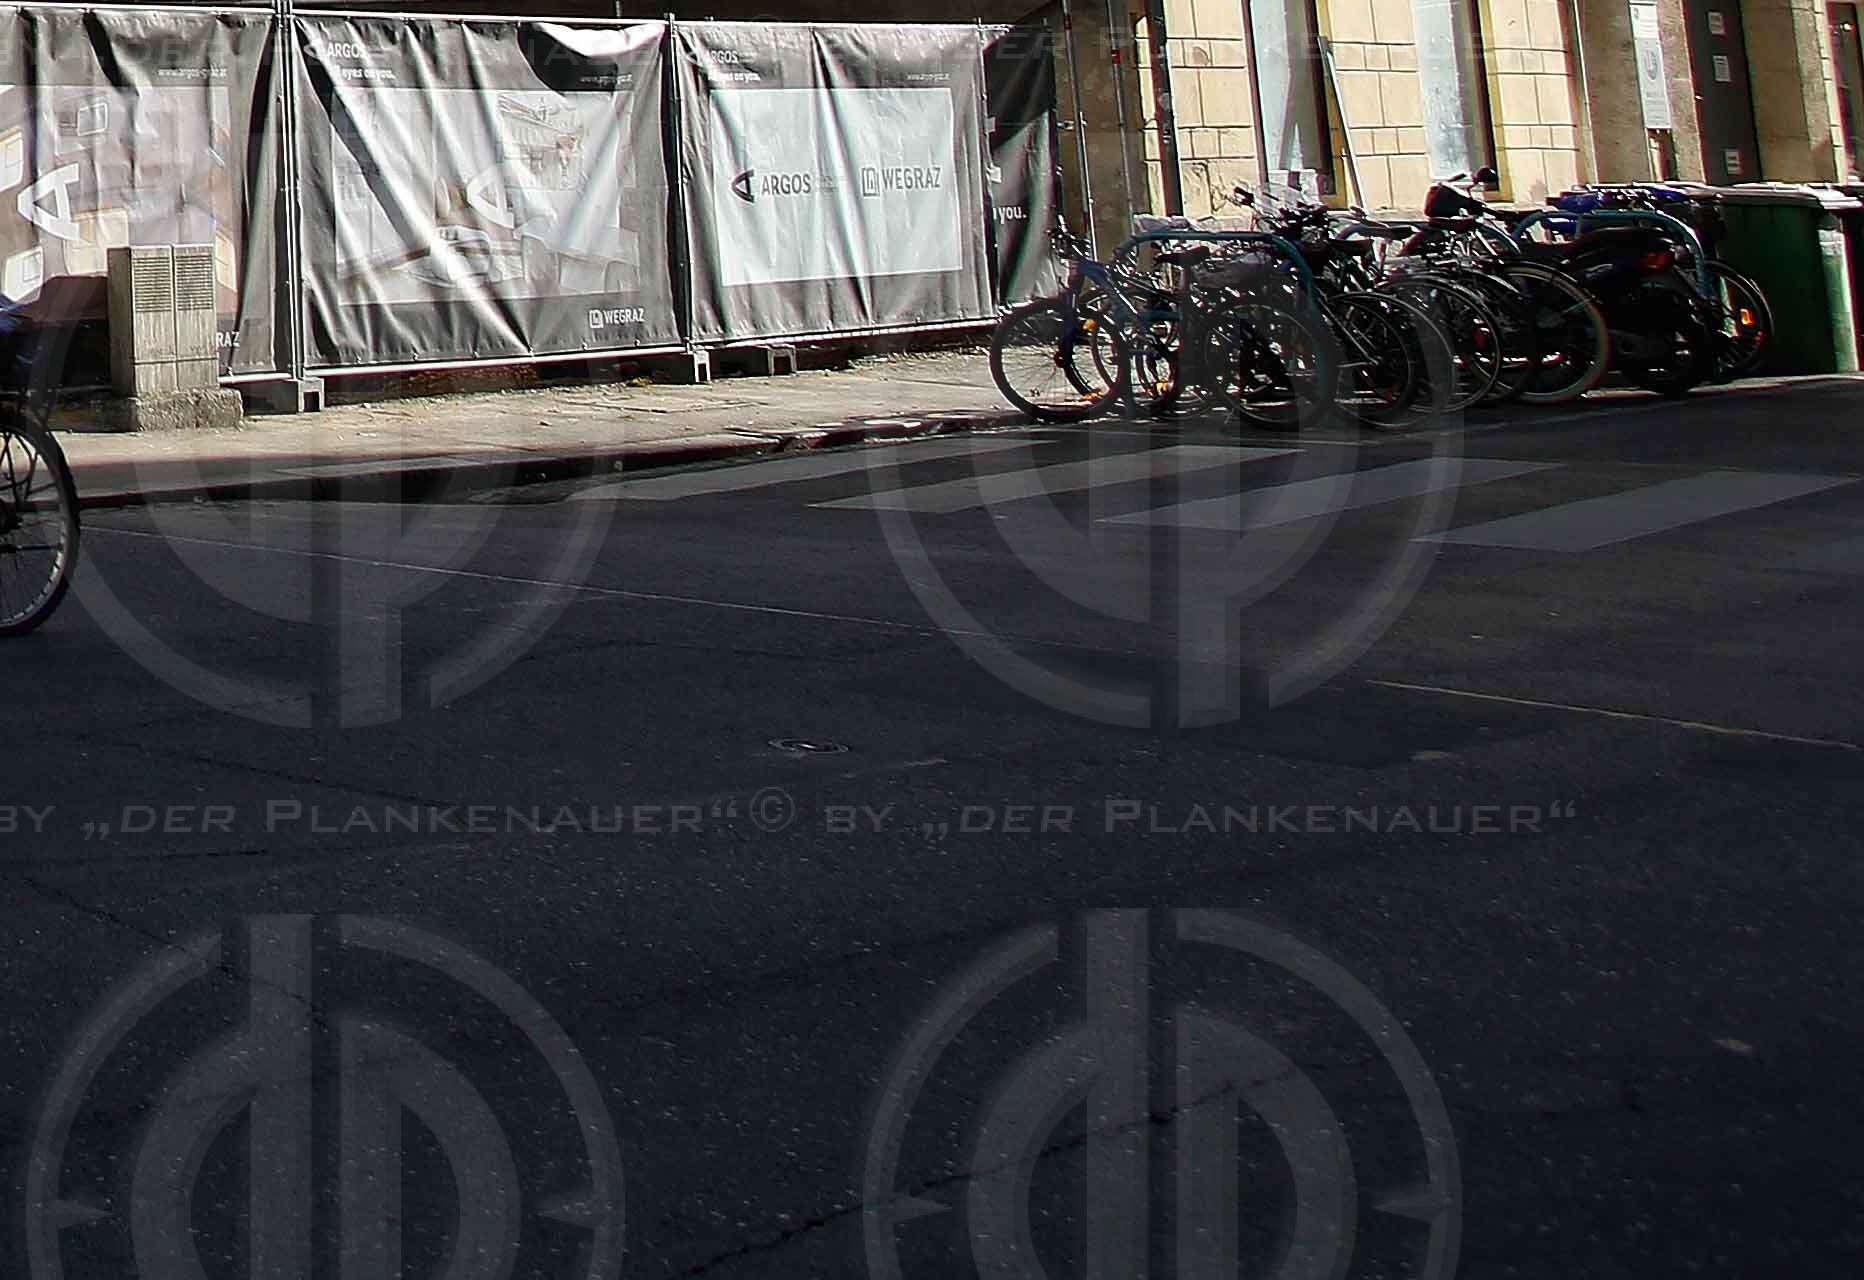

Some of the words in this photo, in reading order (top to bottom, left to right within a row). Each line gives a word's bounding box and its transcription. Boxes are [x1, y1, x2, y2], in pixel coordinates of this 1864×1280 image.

[762, 173, 811, 195] ARGOS
[882, 167, 941, 190] WEGRAZ
[998, 206, 1027, 224] you.
[603, 308, 645, 324] WEGRAZ
